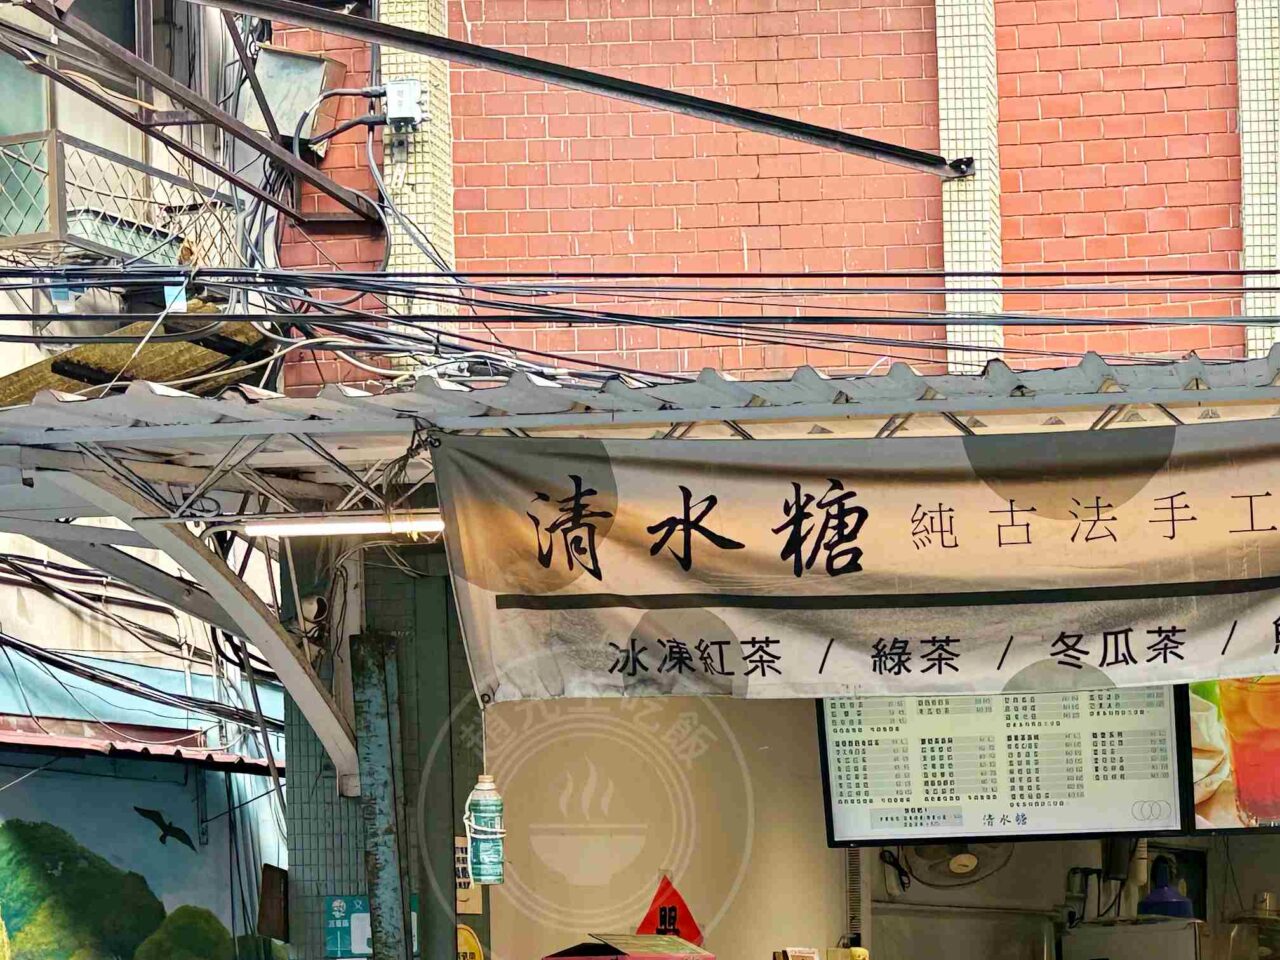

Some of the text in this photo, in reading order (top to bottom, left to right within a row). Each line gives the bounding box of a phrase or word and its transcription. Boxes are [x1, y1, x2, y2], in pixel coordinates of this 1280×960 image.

[526, 474, 870, 582] 清水糖
[608, 636, 782, 679] 冰凍紅茶
[871, 636, 961, 676] 綠茶
[1049, 625, 1187, 670] 冬瓜茶
